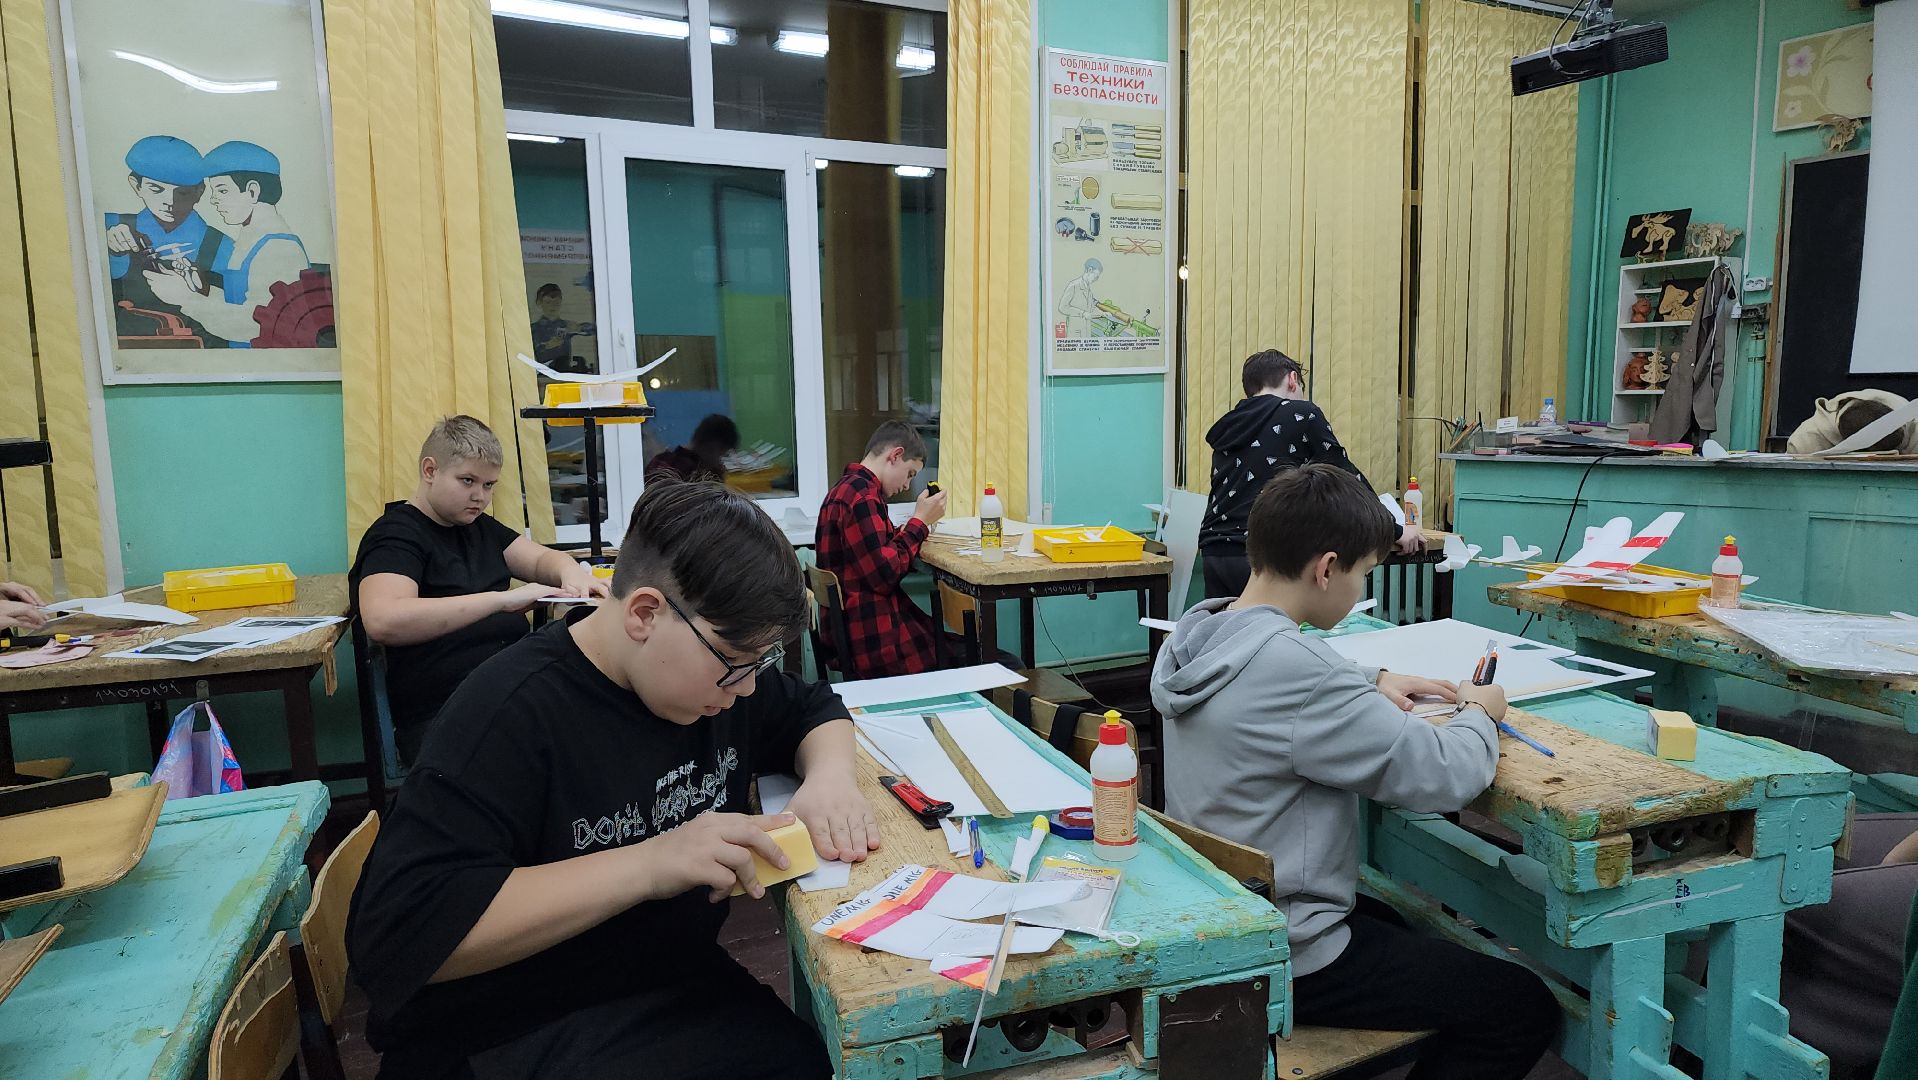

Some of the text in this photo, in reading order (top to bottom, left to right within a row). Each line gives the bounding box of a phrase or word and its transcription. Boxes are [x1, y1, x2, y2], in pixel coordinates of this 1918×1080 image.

[1060, 57, 1153, 77] СОБЛЮДАЙ ПРАВИЛА
[678, 760, 698, 779] RISK
